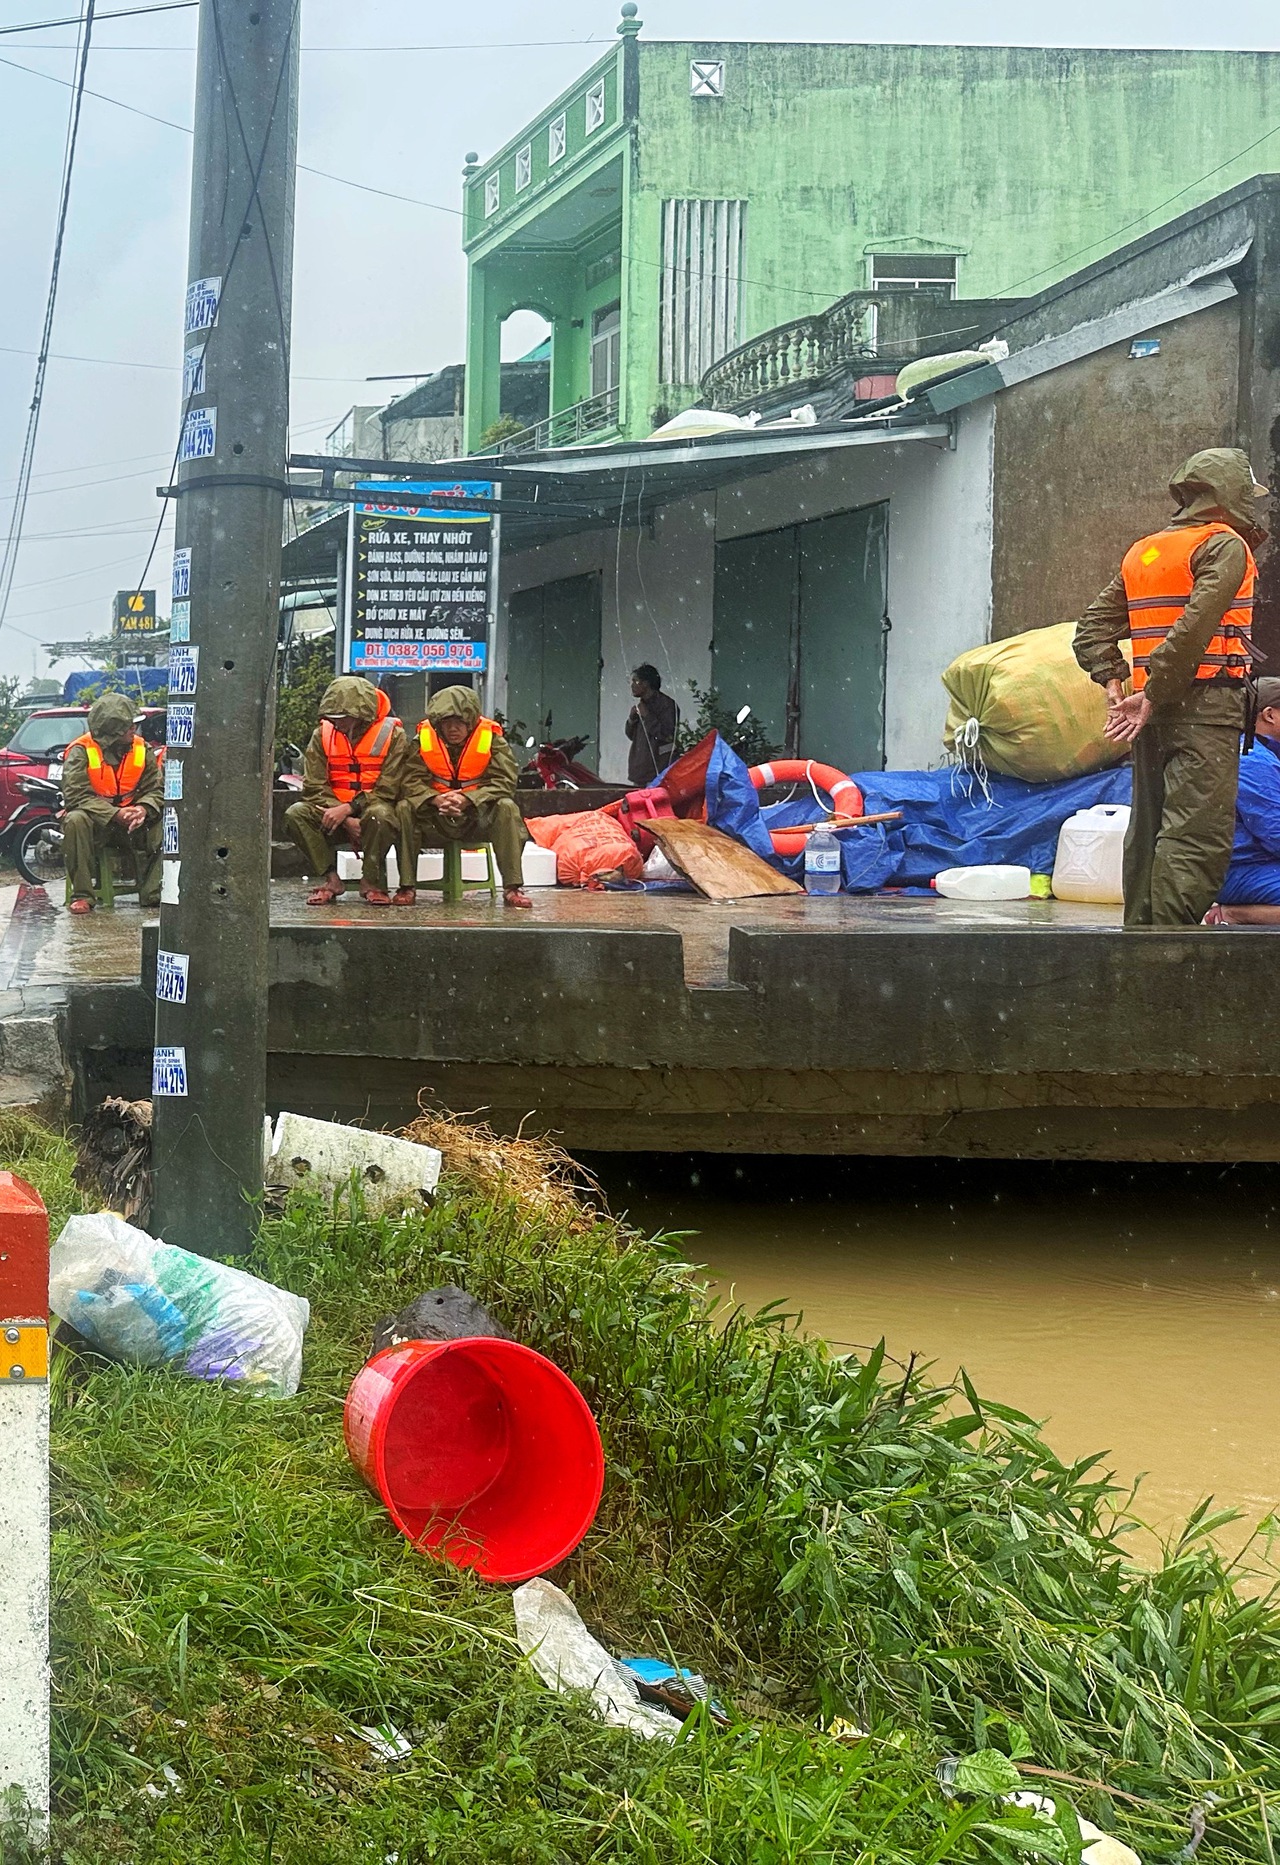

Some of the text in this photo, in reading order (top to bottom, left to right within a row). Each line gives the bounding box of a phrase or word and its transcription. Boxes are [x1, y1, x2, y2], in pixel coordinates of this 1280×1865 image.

[393, 532, 411, 545] XE,
[413, 532, 441, 544] THAY
[443, 530, 473, 544] NHỚT
[451, 570, 460, 582] XE
[473, 569, 487, 582] MÁY
[380, 589, 388, 601] XE
[388, 590, 404, 601] THEO
[397, 609, 408, 620] XE
[409, 607, 427, 620] MÁY
[138, 615, 154, 629] 481
[366, 644, 473, 657] ĐT: 0382 056 976
[173, 705, 193, 716] THƠM
